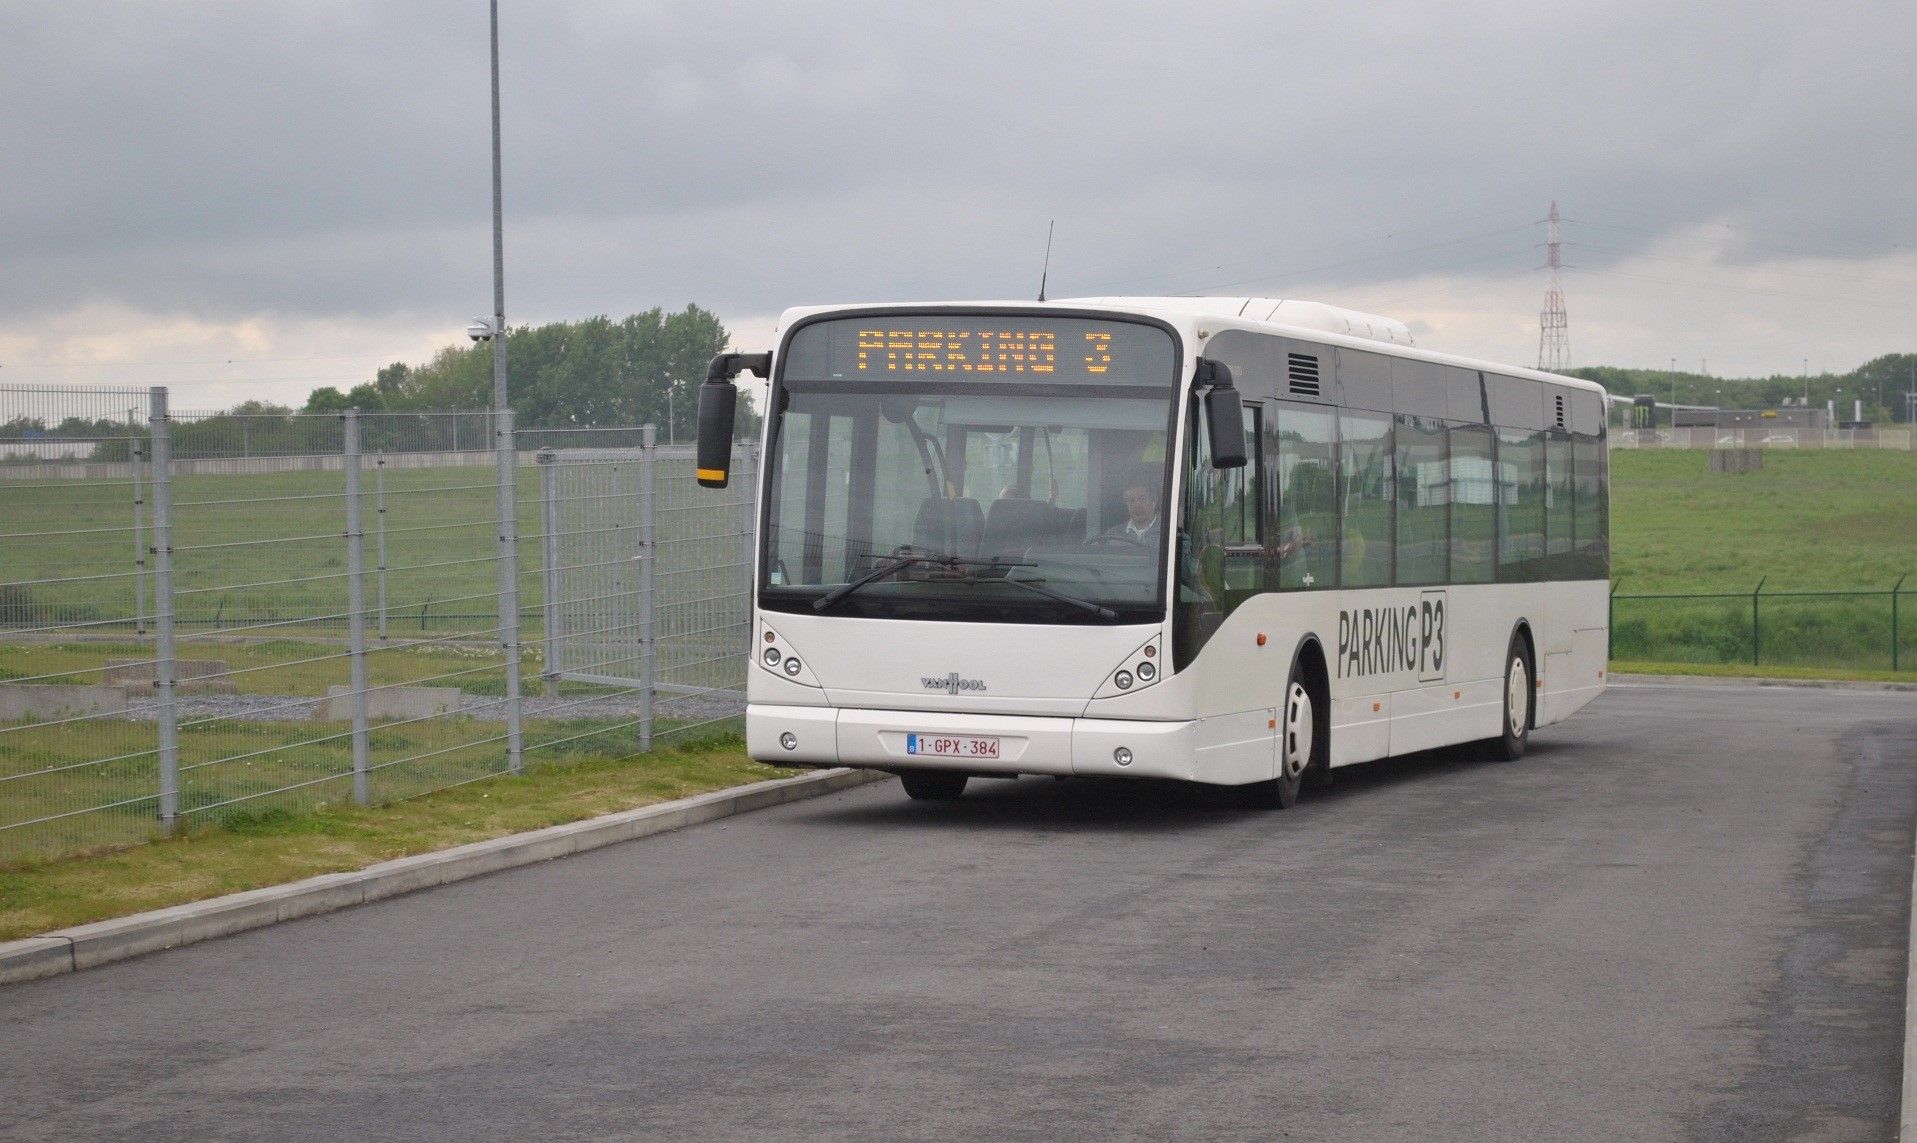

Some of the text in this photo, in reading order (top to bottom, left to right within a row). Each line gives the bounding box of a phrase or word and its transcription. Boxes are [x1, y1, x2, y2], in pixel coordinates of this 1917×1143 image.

[859, 331, 1111, 372] PARKING 3
[1338, 599, 1444, 679] PARKING P3
